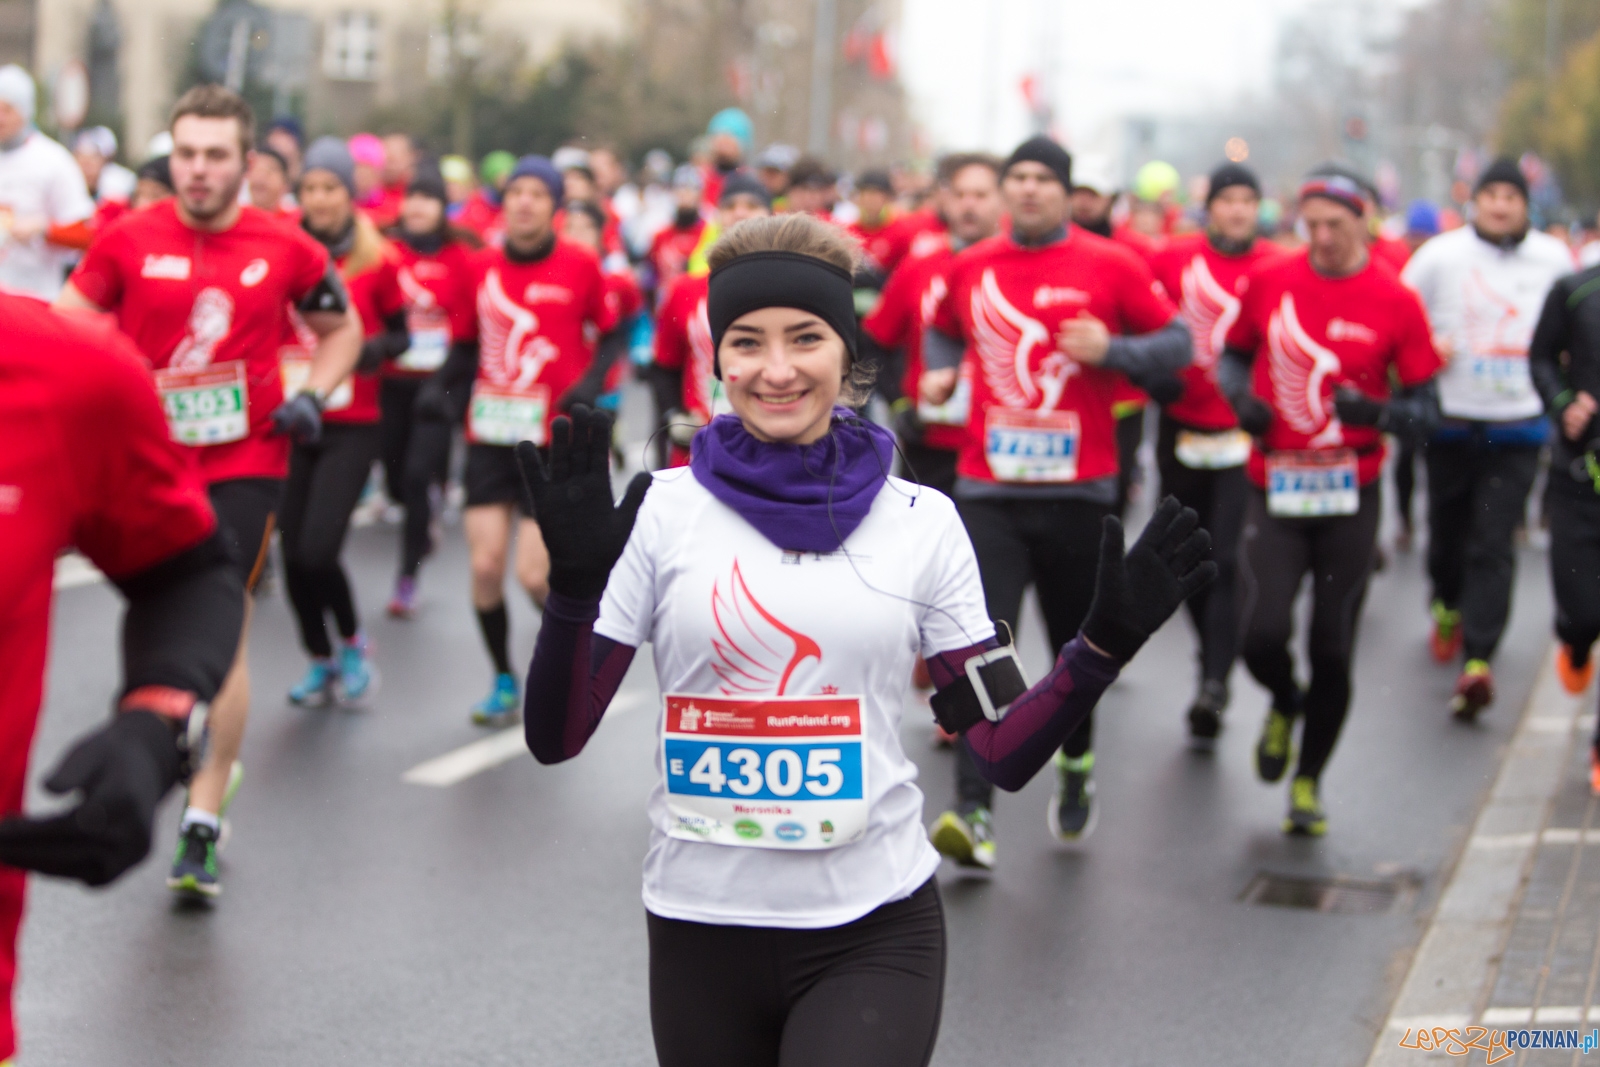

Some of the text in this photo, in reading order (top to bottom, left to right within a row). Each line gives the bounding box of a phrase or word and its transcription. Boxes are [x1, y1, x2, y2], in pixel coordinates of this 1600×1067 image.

[766, 714, 851, 728] RunPoland.org
[669, 746, 845, 797] E 4305
[732, 804, 793, 815] Weronika
